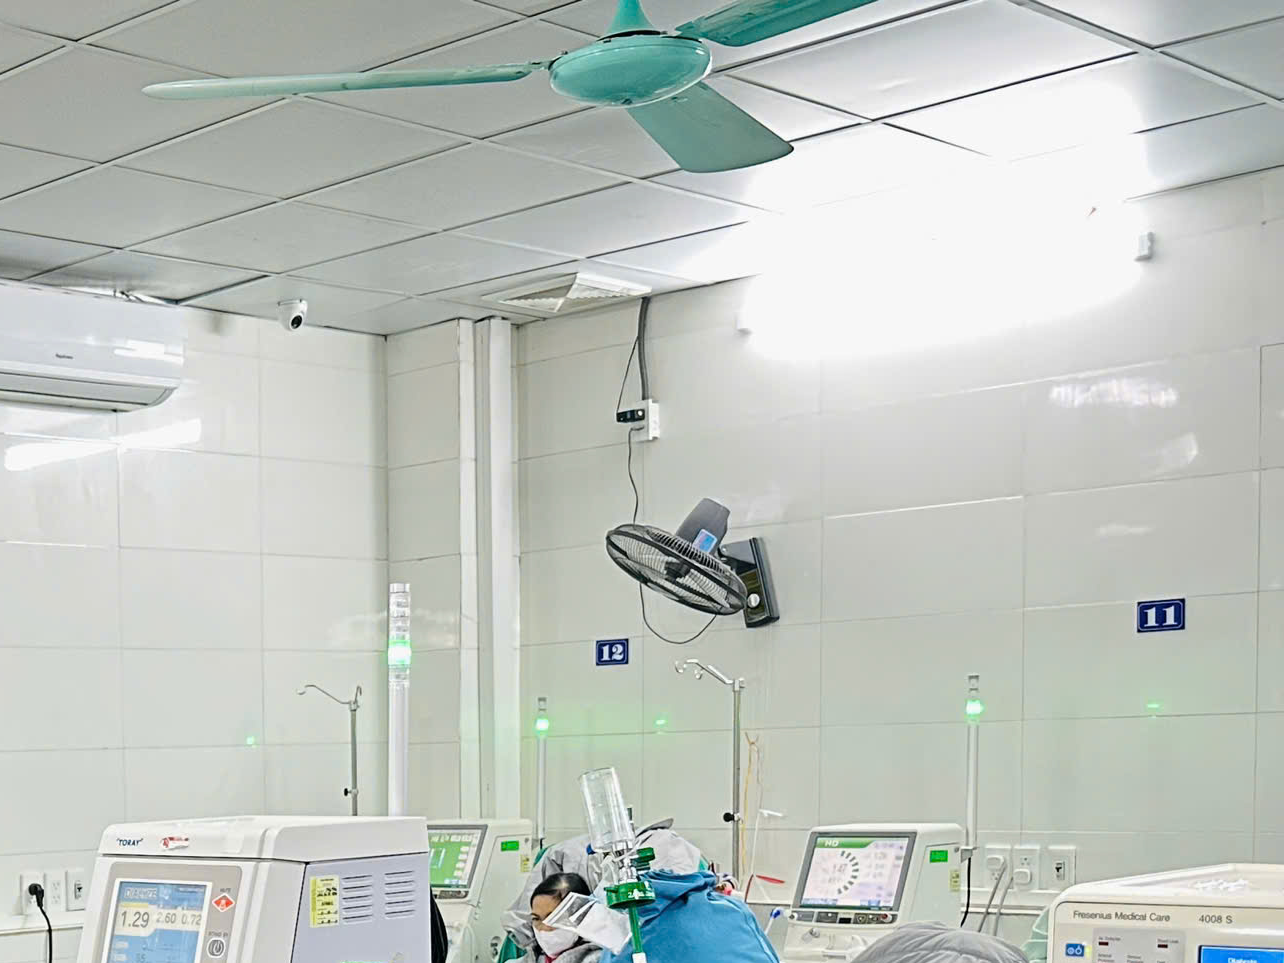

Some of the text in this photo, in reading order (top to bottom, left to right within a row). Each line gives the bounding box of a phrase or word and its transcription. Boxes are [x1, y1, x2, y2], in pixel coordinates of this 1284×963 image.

[1144, 605, 1178, 627] 11
[601, 643, 624, 661] 12
[121, 910, 202, 928] 1.29 2.60 0.72
[1073, 910, 1170, 922] Fresenius Medical Care
[1199, 914, 1233, 924] 4008 S
